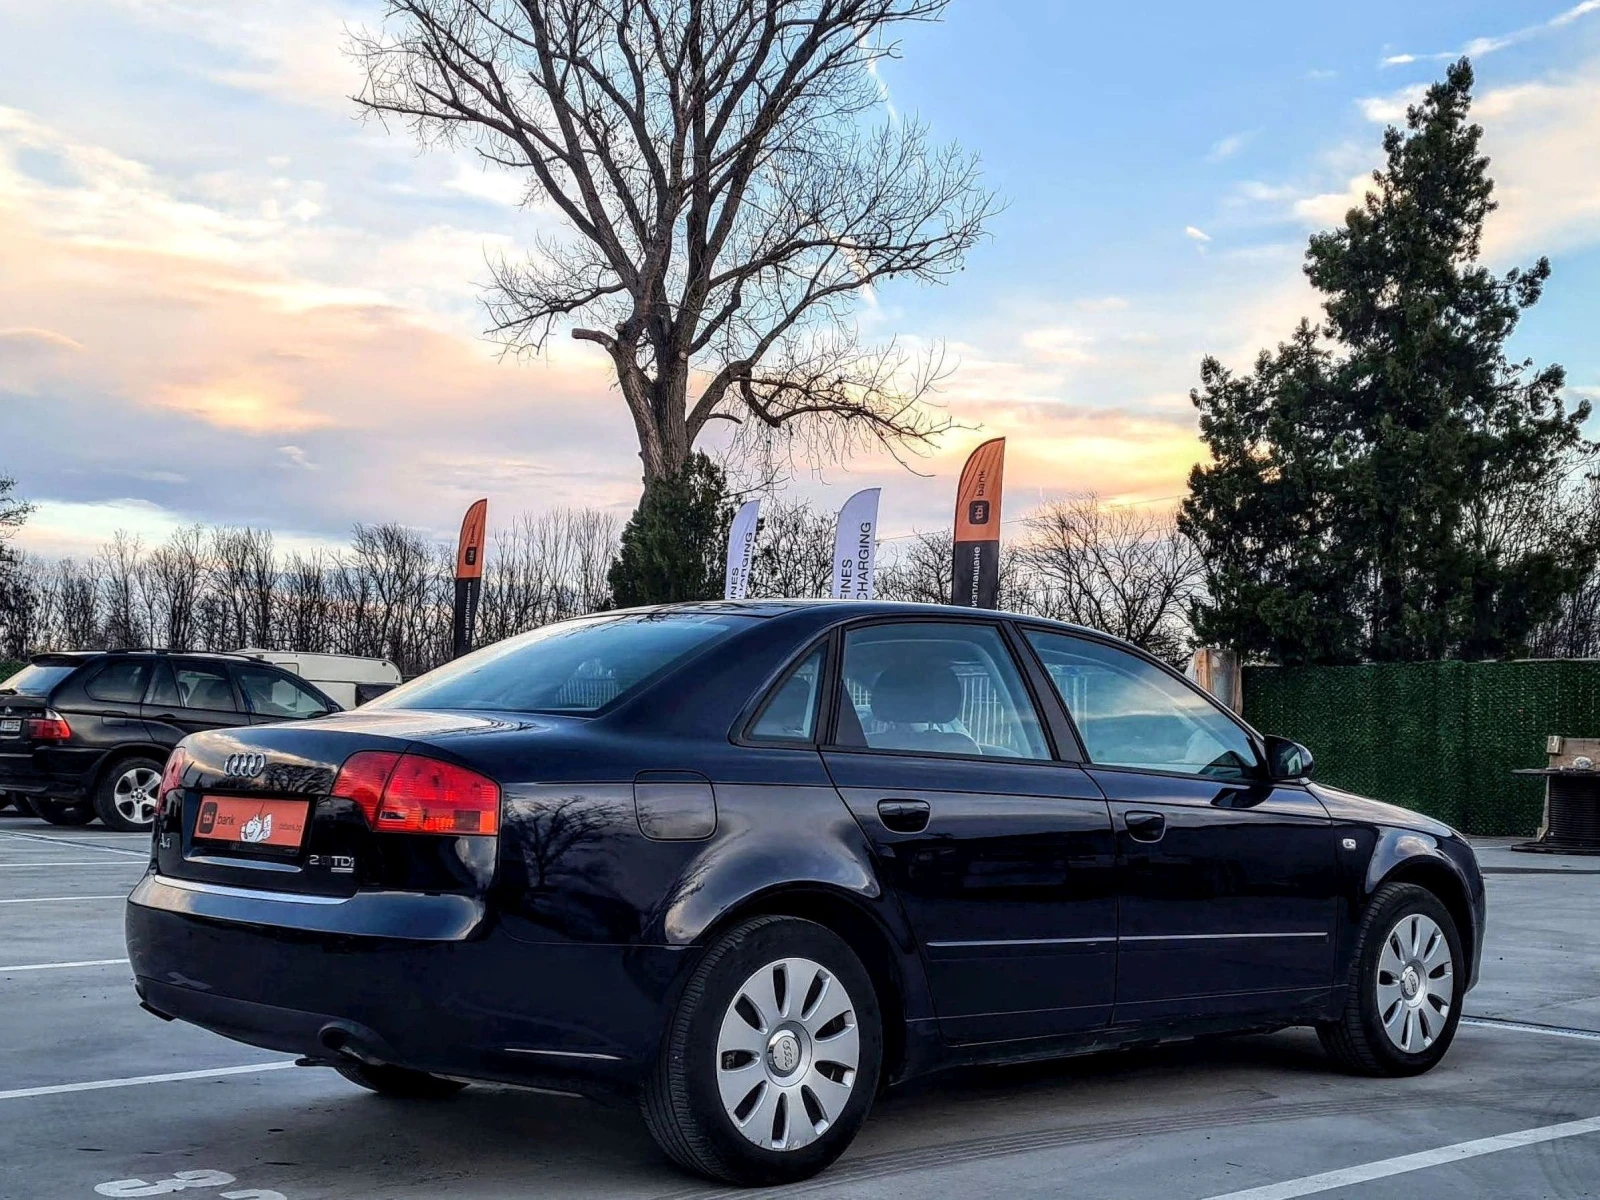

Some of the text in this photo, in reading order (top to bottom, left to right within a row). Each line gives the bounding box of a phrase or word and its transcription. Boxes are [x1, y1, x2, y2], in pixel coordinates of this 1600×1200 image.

[975, 470, 986, 520] tbi bank
[857, 522, 870, 600] CHARGING
[217, 813, 235, 825] bank
